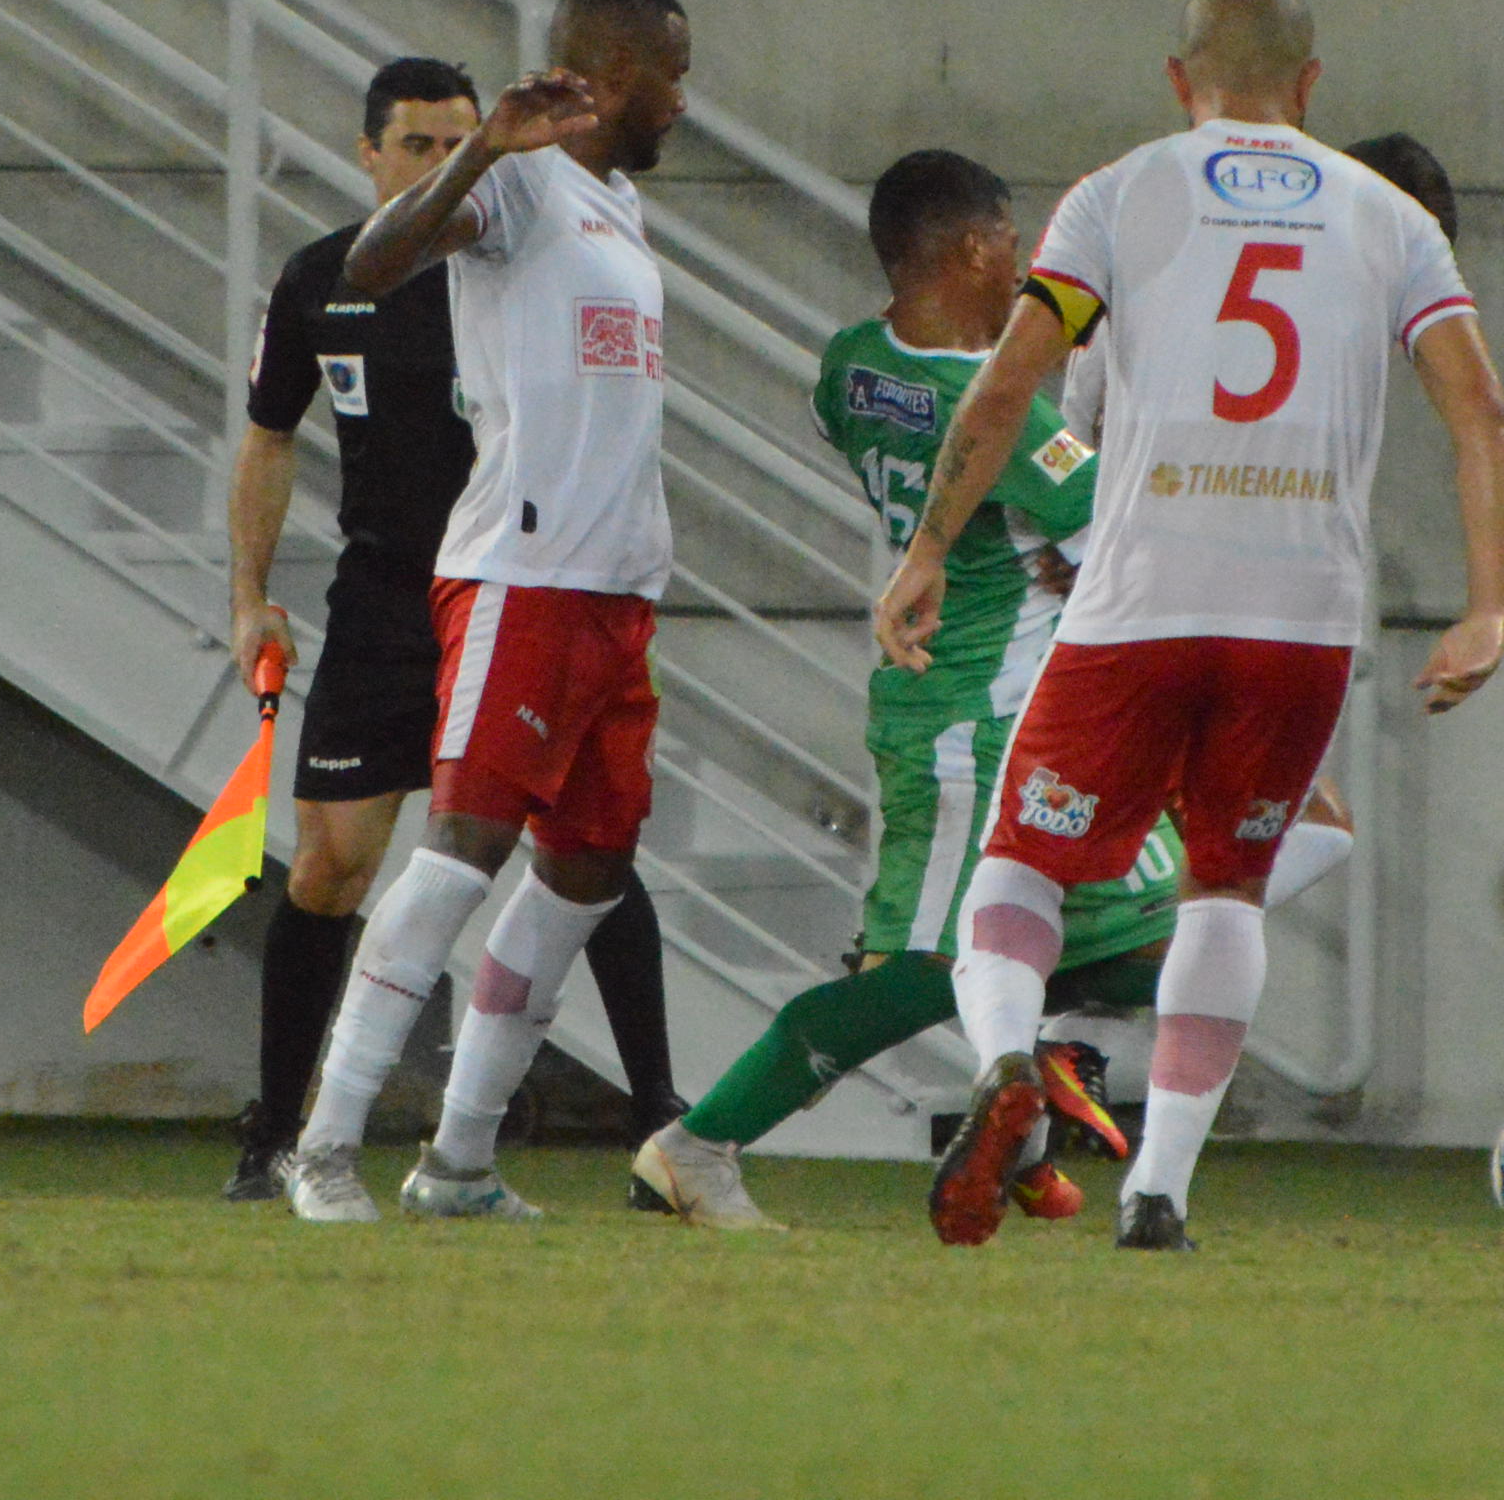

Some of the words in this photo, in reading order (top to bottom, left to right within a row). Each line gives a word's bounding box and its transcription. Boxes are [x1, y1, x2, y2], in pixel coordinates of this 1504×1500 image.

[325, 301, 376, 315] Kappa
[1212, 241, 1305, 424] 5
[861, 446, 927, 555] 16
[308, 756, 363, 771] Kappa
[1019, 799, 1091, 838] TODO
